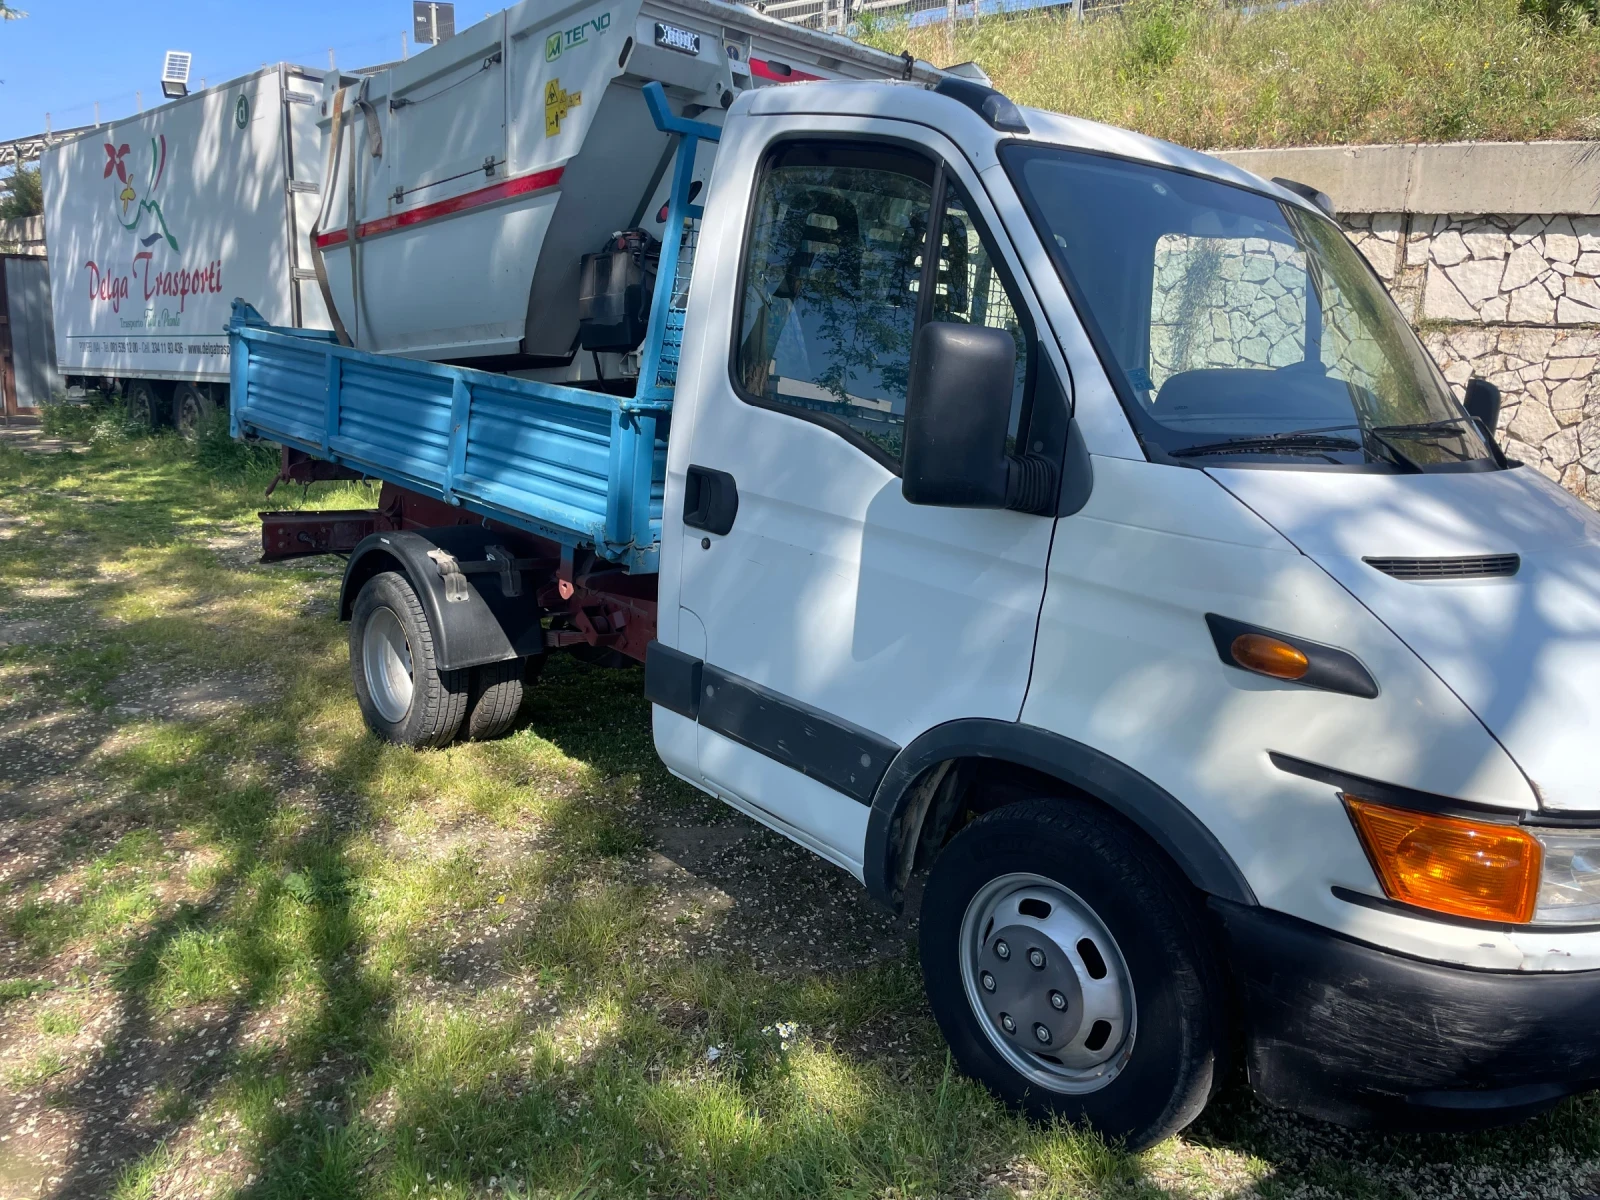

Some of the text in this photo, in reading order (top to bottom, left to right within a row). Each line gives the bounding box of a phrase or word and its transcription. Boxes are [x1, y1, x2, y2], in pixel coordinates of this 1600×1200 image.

[84, 251, 223, 313] Delga Trasporti
[120, 317, 144, 330] Trasporto
[152, 342, 160, 354] 334
[160, 342, 166, 354] 11
